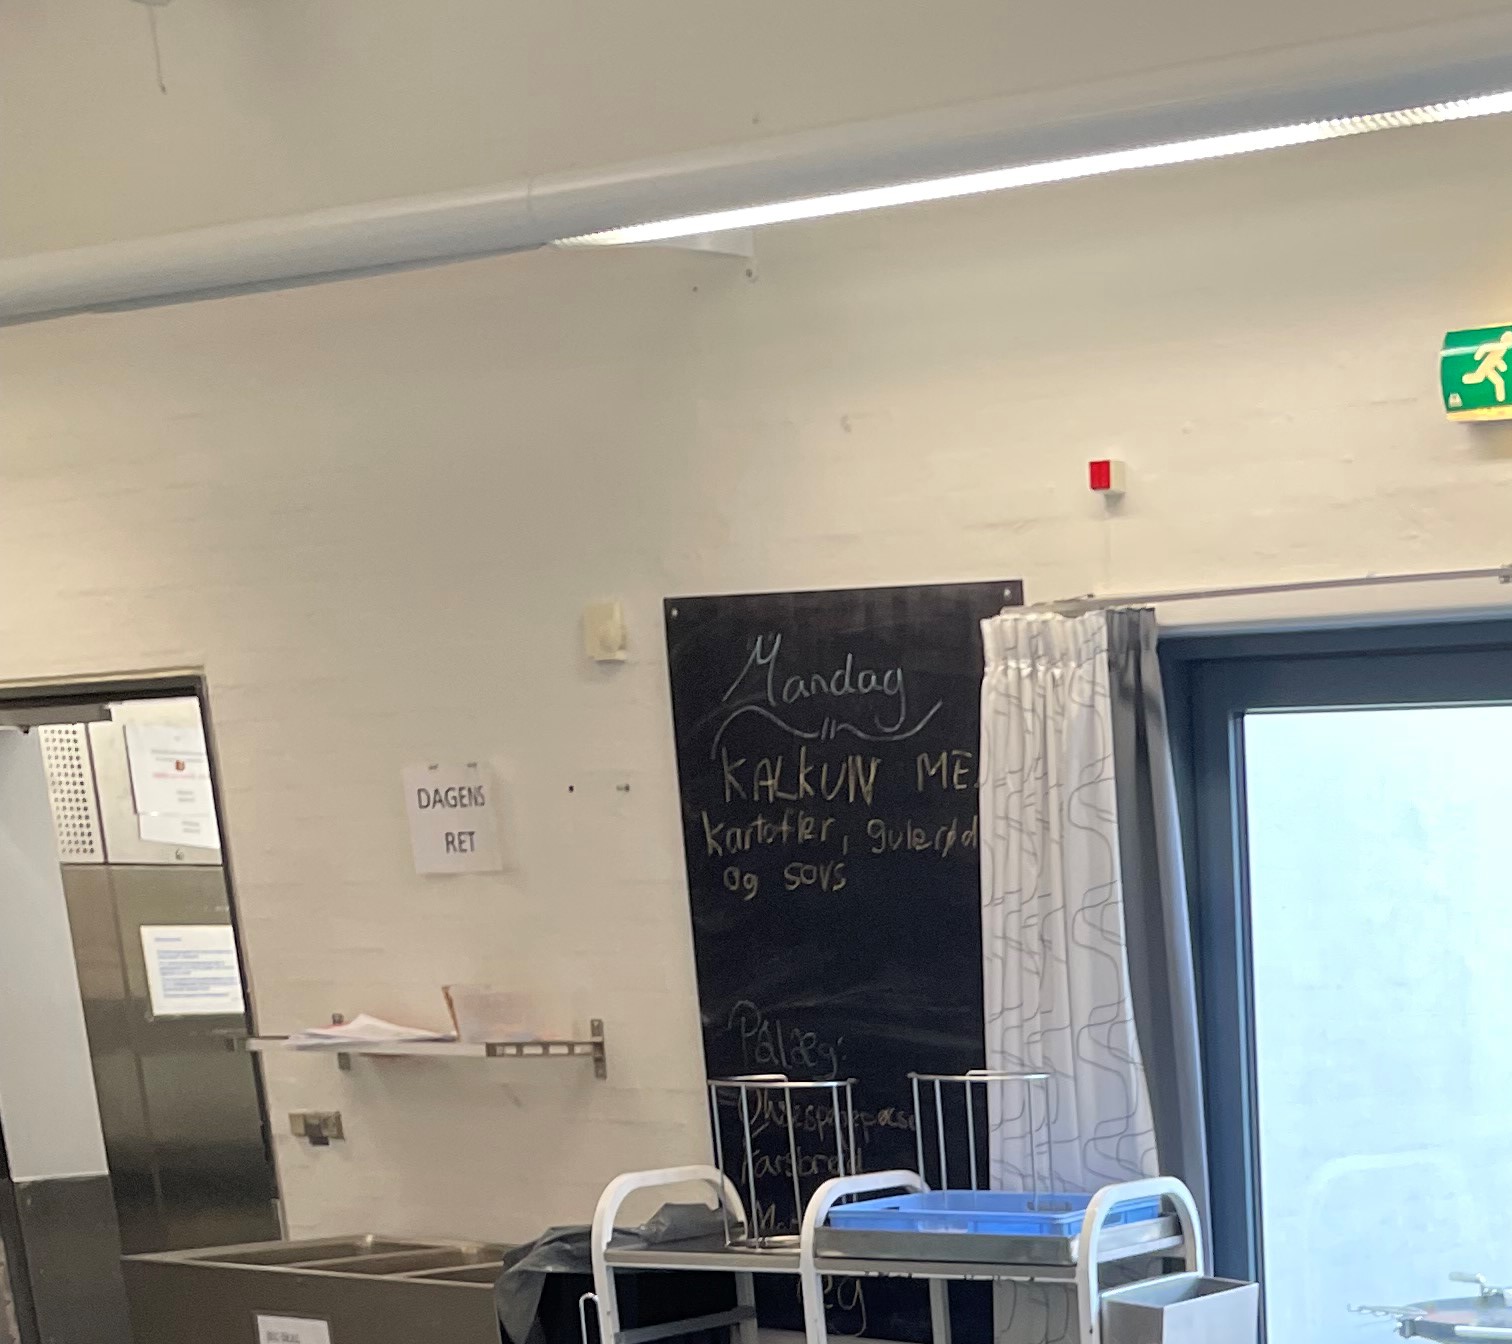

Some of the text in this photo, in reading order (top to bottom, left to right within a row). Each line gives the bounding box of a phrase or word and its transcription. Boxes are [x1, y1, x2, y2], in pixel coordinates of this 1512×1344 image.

[720, 631, 907, 733] Mandag
[416, 785, 486, 810] DAGENS
[721, 745, 979, 807] KALKUN ME
[444, 830, 476, 854] RET
